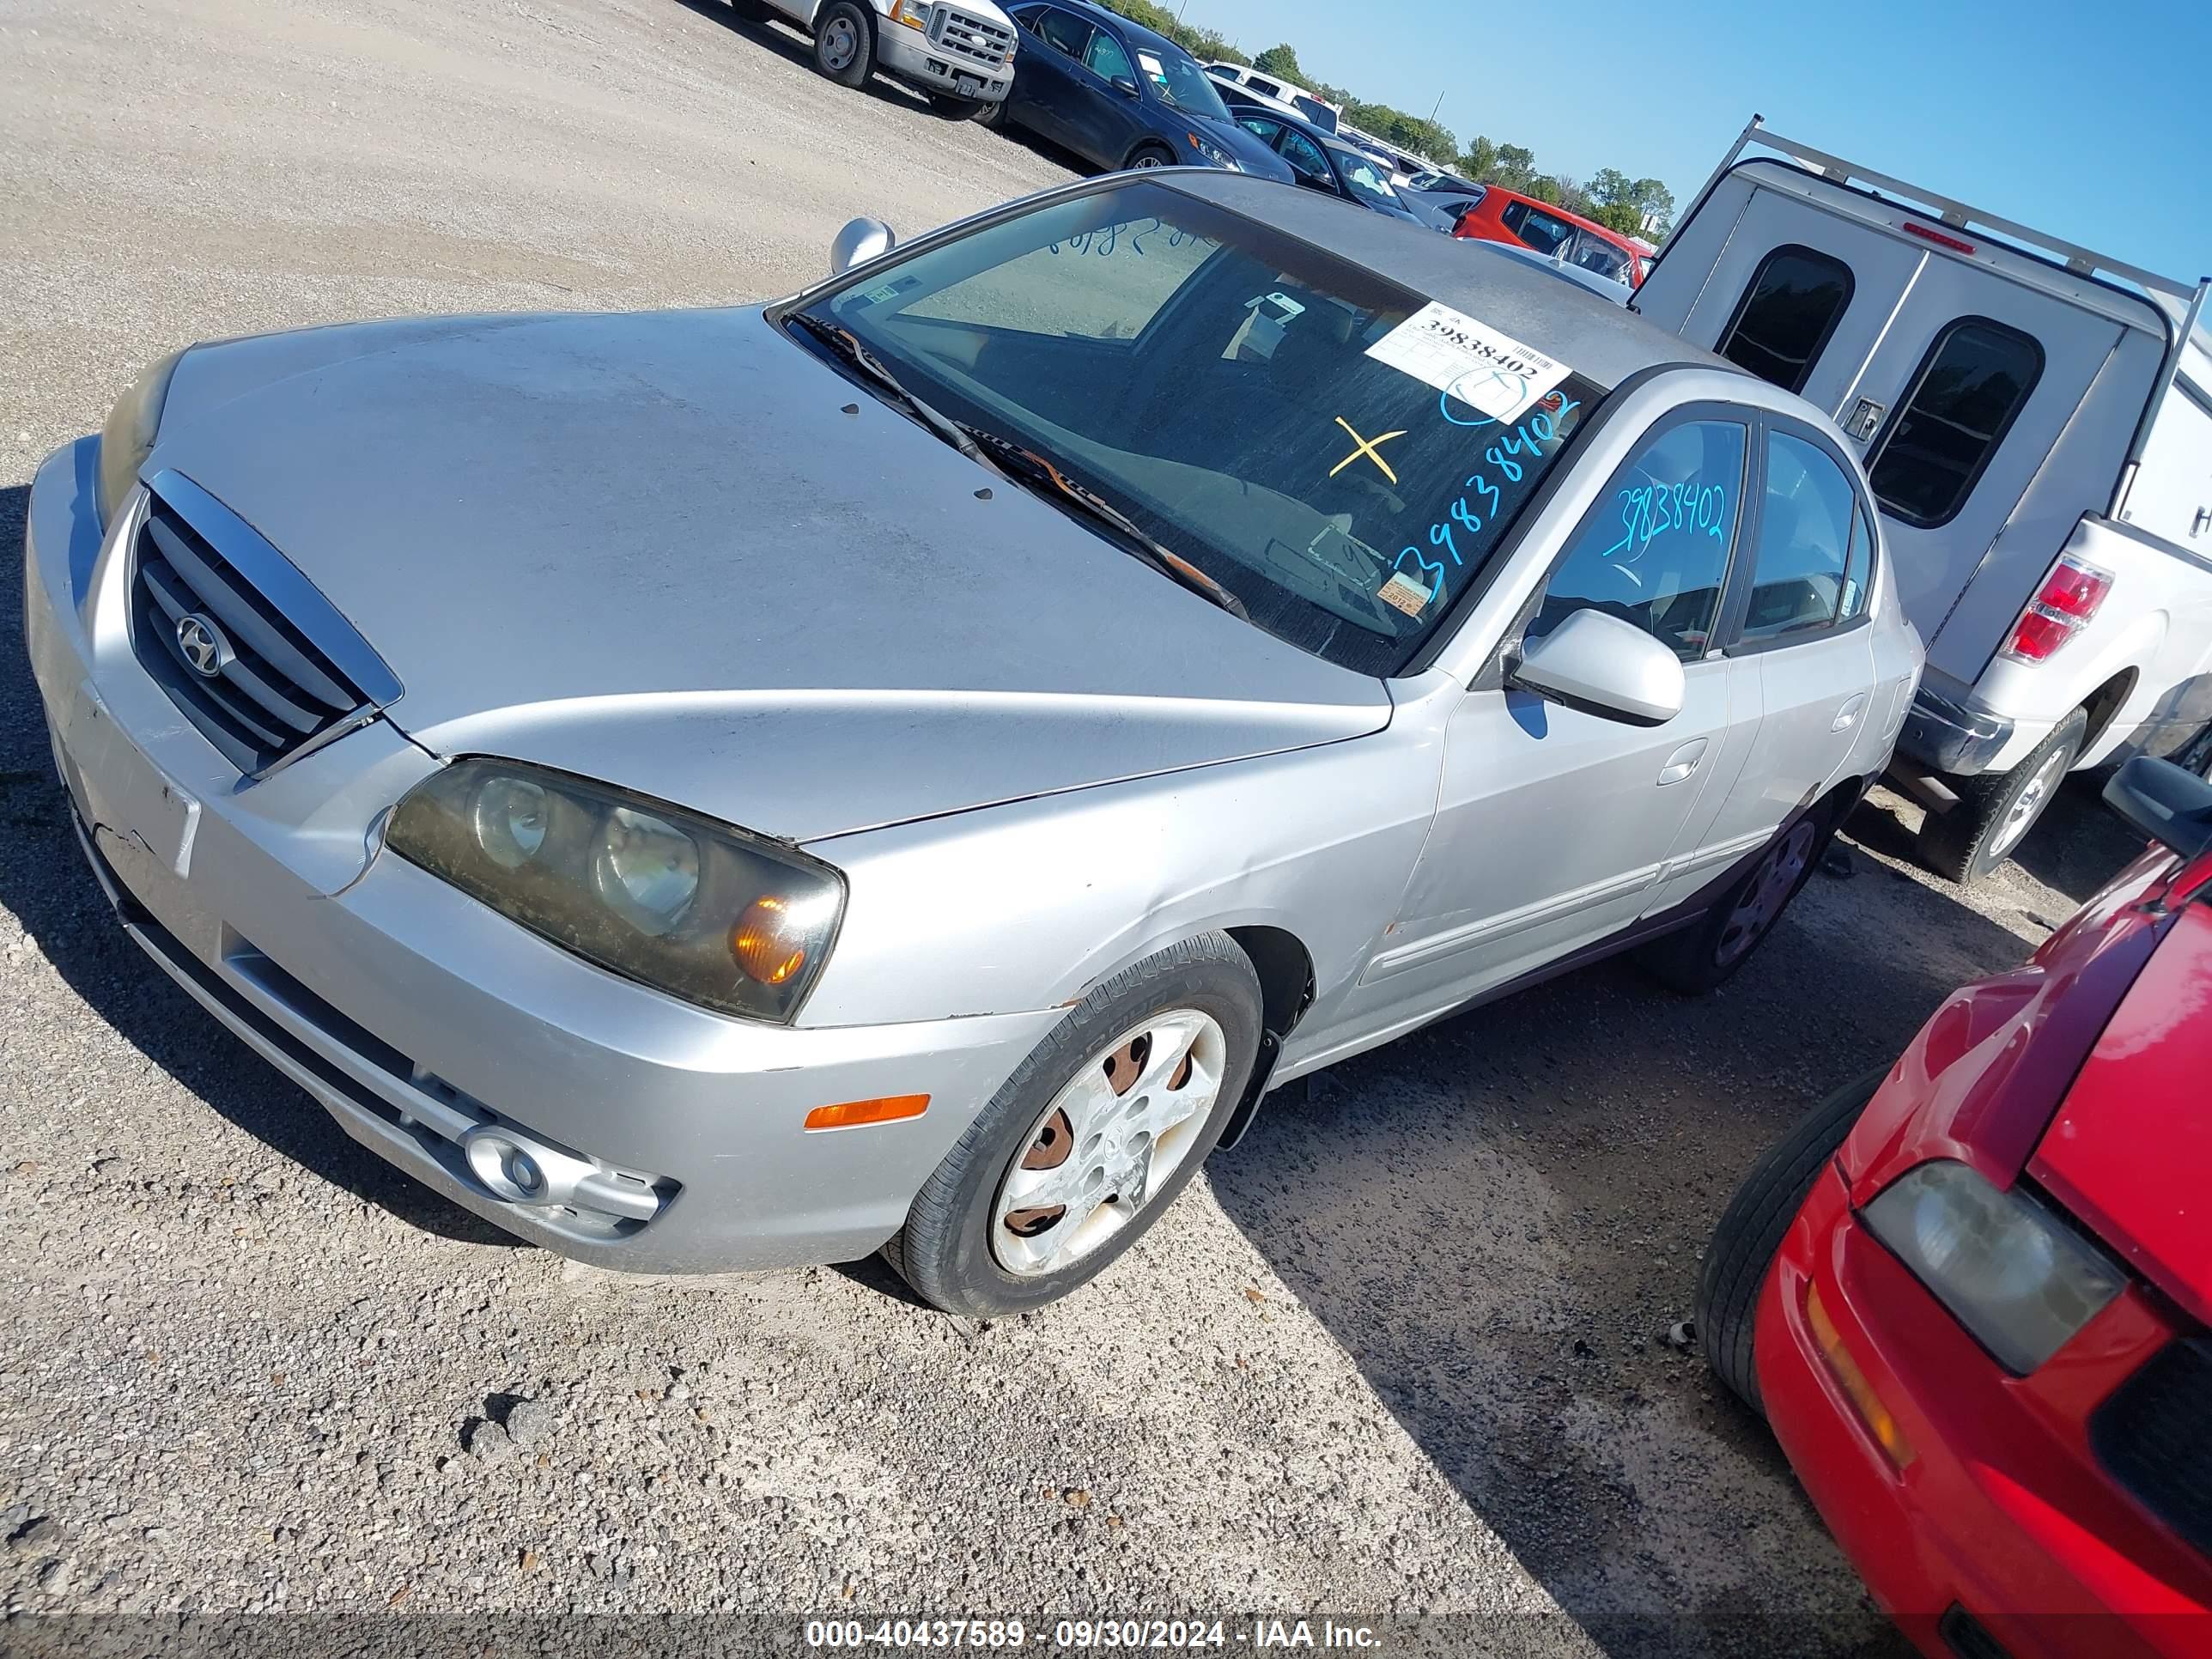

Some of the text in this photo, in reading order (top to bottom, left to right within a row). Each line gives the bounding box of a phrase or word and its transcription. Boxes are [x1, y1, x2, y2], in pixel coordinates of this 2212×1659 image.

[1421, 319, 1538, 380] 39838402
[1394, 391, 1581, 604] 39838402
[1602, 482, 1724, 556] 39838402
[1388, 592, 1407, 606] 2012
